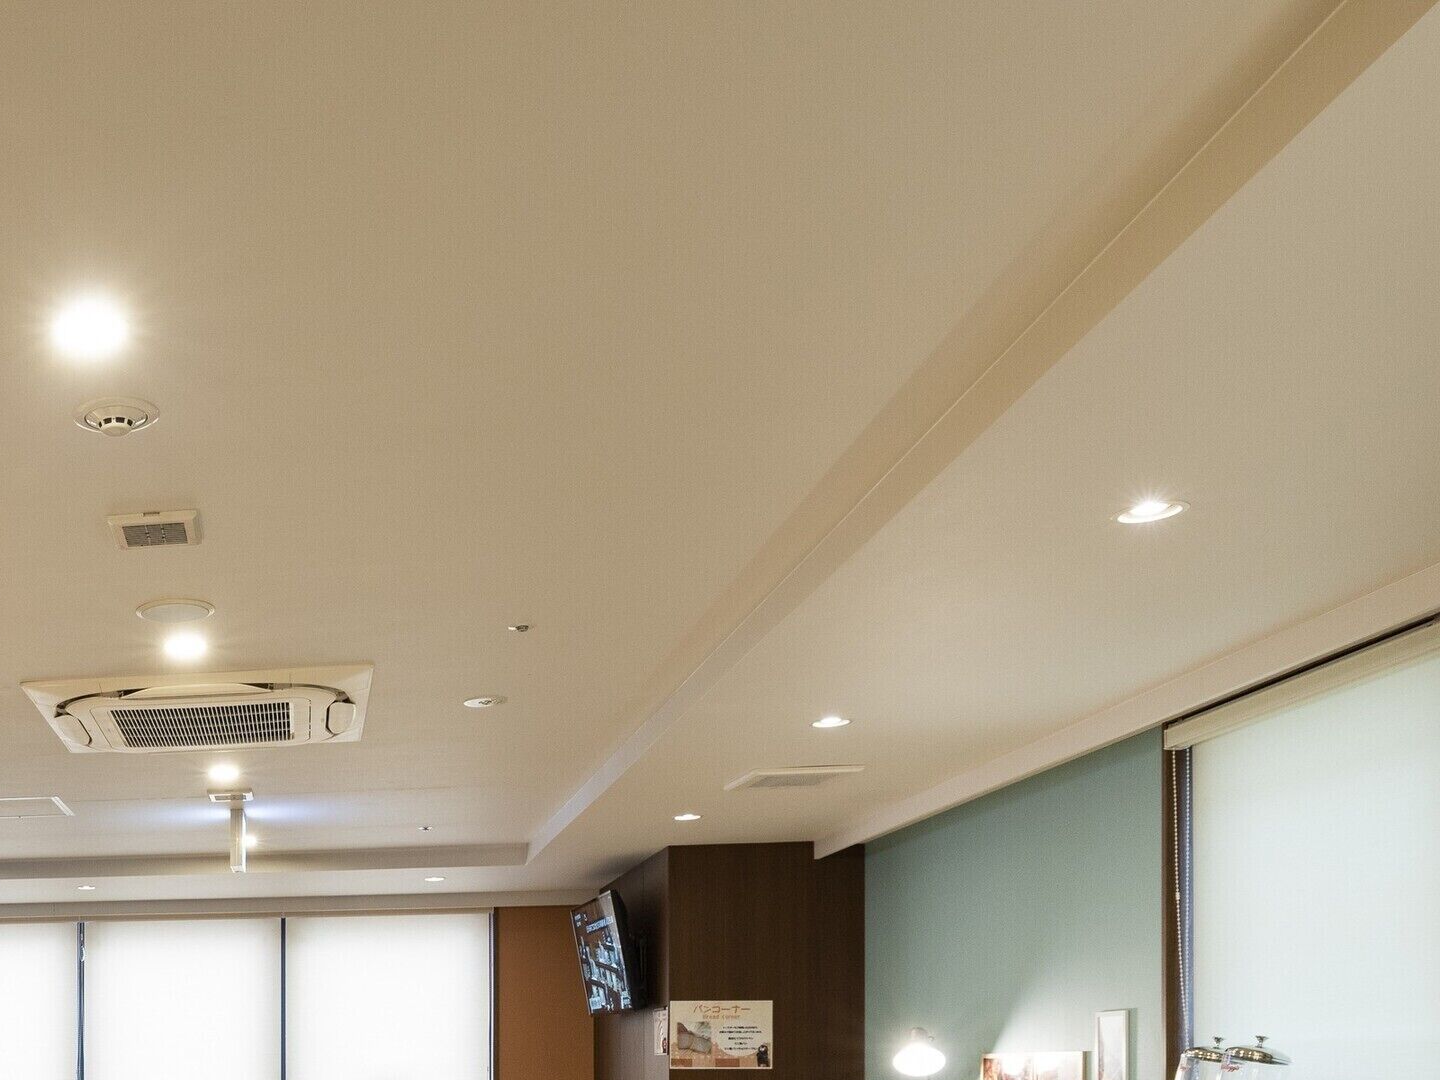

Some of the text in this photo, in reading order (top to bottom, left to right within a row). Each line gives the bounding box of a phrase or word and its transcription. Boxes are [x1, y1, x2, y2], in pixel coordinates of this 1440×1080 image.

[693, 1004, 751, 1014] パンコーナー
